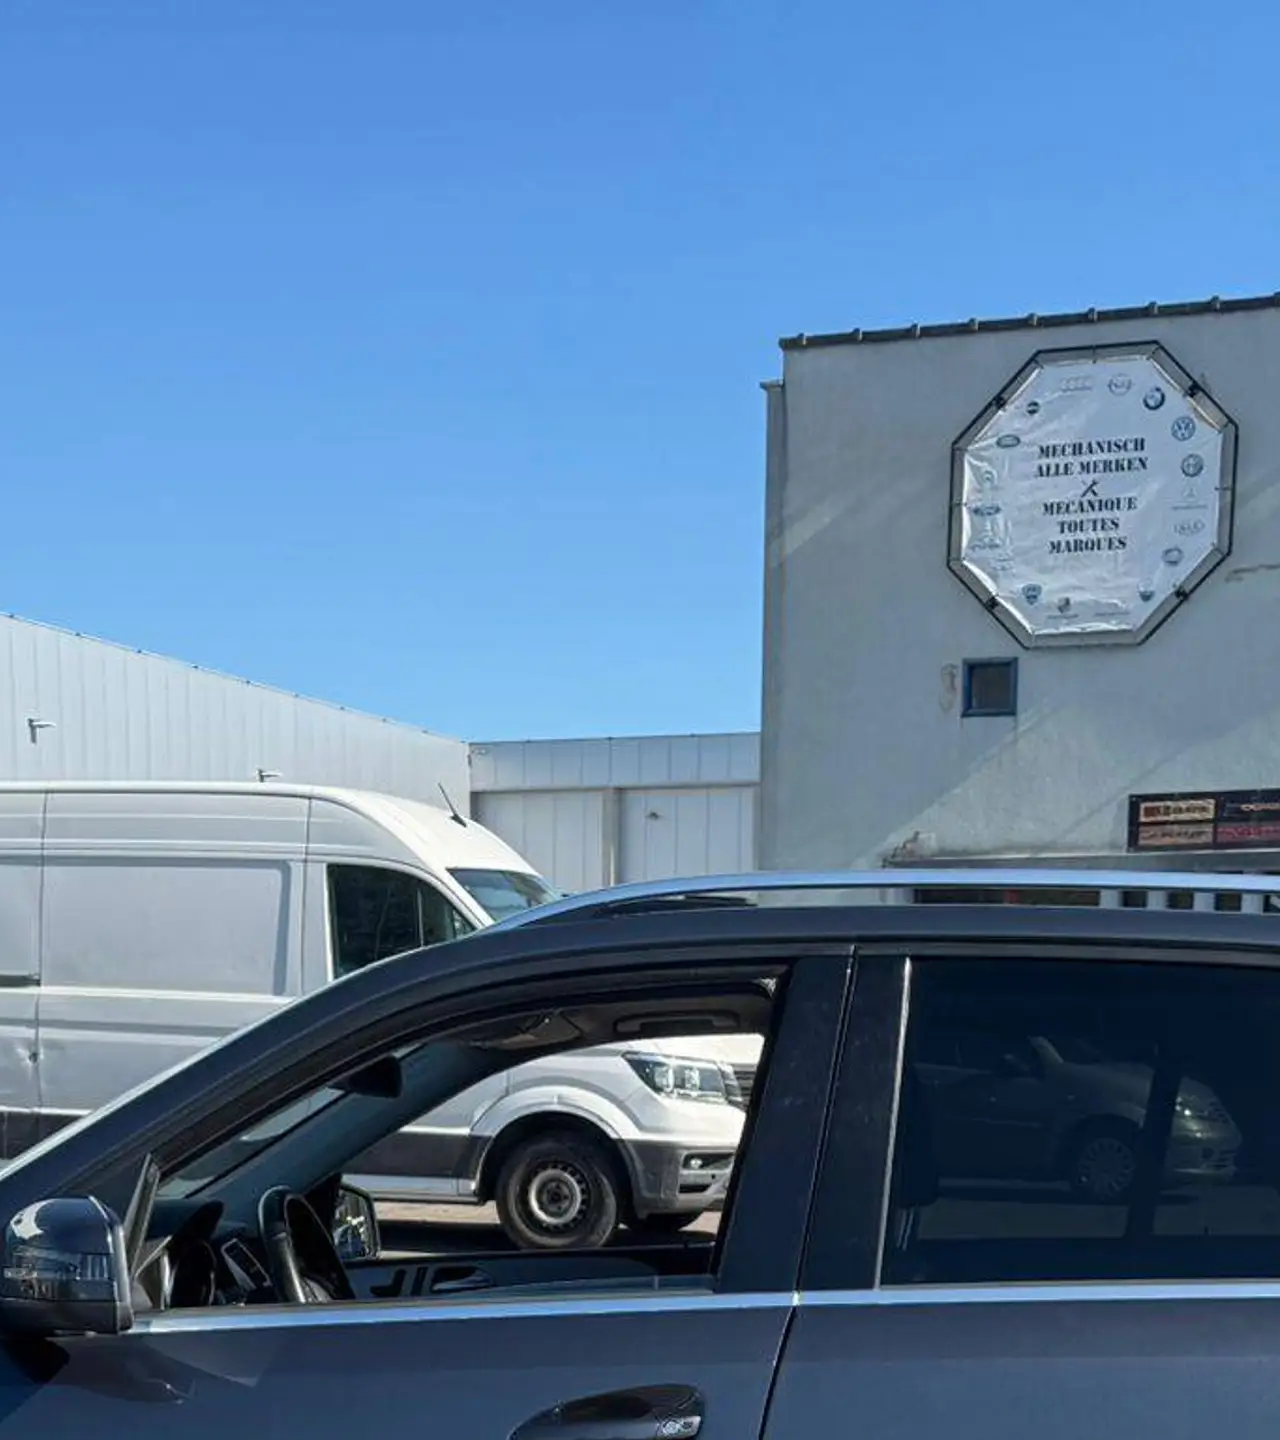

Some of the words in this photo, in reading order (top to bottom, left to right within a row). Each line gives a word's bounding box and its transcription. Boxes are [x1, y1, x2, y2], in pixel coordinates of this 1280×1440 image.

[1038, 437, 1146, 459] MECHANISCH
[1035, 461, 1074, 479] ALLE
[1077, 456, 1149, 476] MERKEN
[1042, 496, 1138, 516] MECANIQUE
[1056, 517, 1120, 535] TOUTES
[1048, 535, 1128, 555] MARQUES
